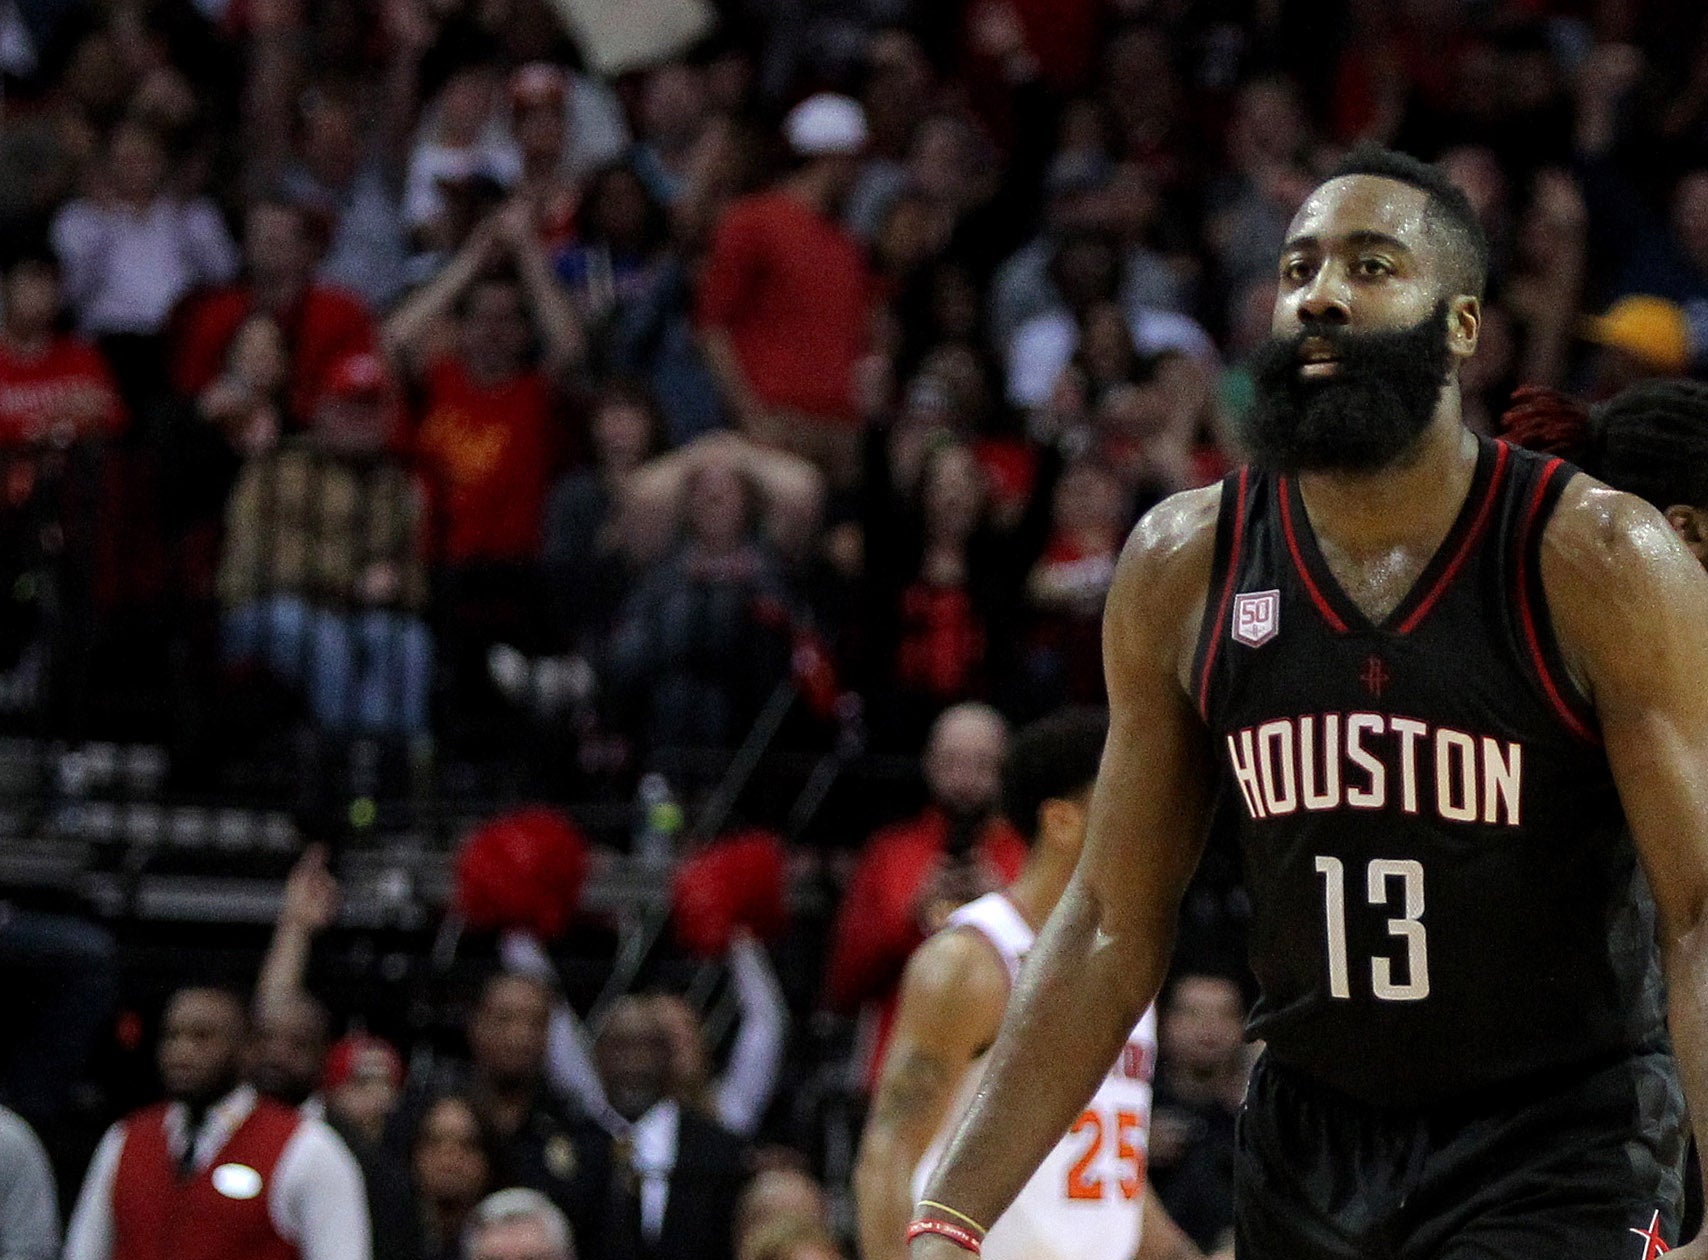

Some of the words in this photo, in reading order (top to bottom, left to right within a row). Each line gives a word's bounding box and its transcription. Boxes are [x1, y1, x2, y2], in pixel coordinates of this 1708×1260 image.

[1241, 599, 1271, 625] 50
[1226, 711, 1523, 827] HOUSTON
[1314, 854, 1431, 1001] 13
[1068, 1110, 1150, 1200] 25
